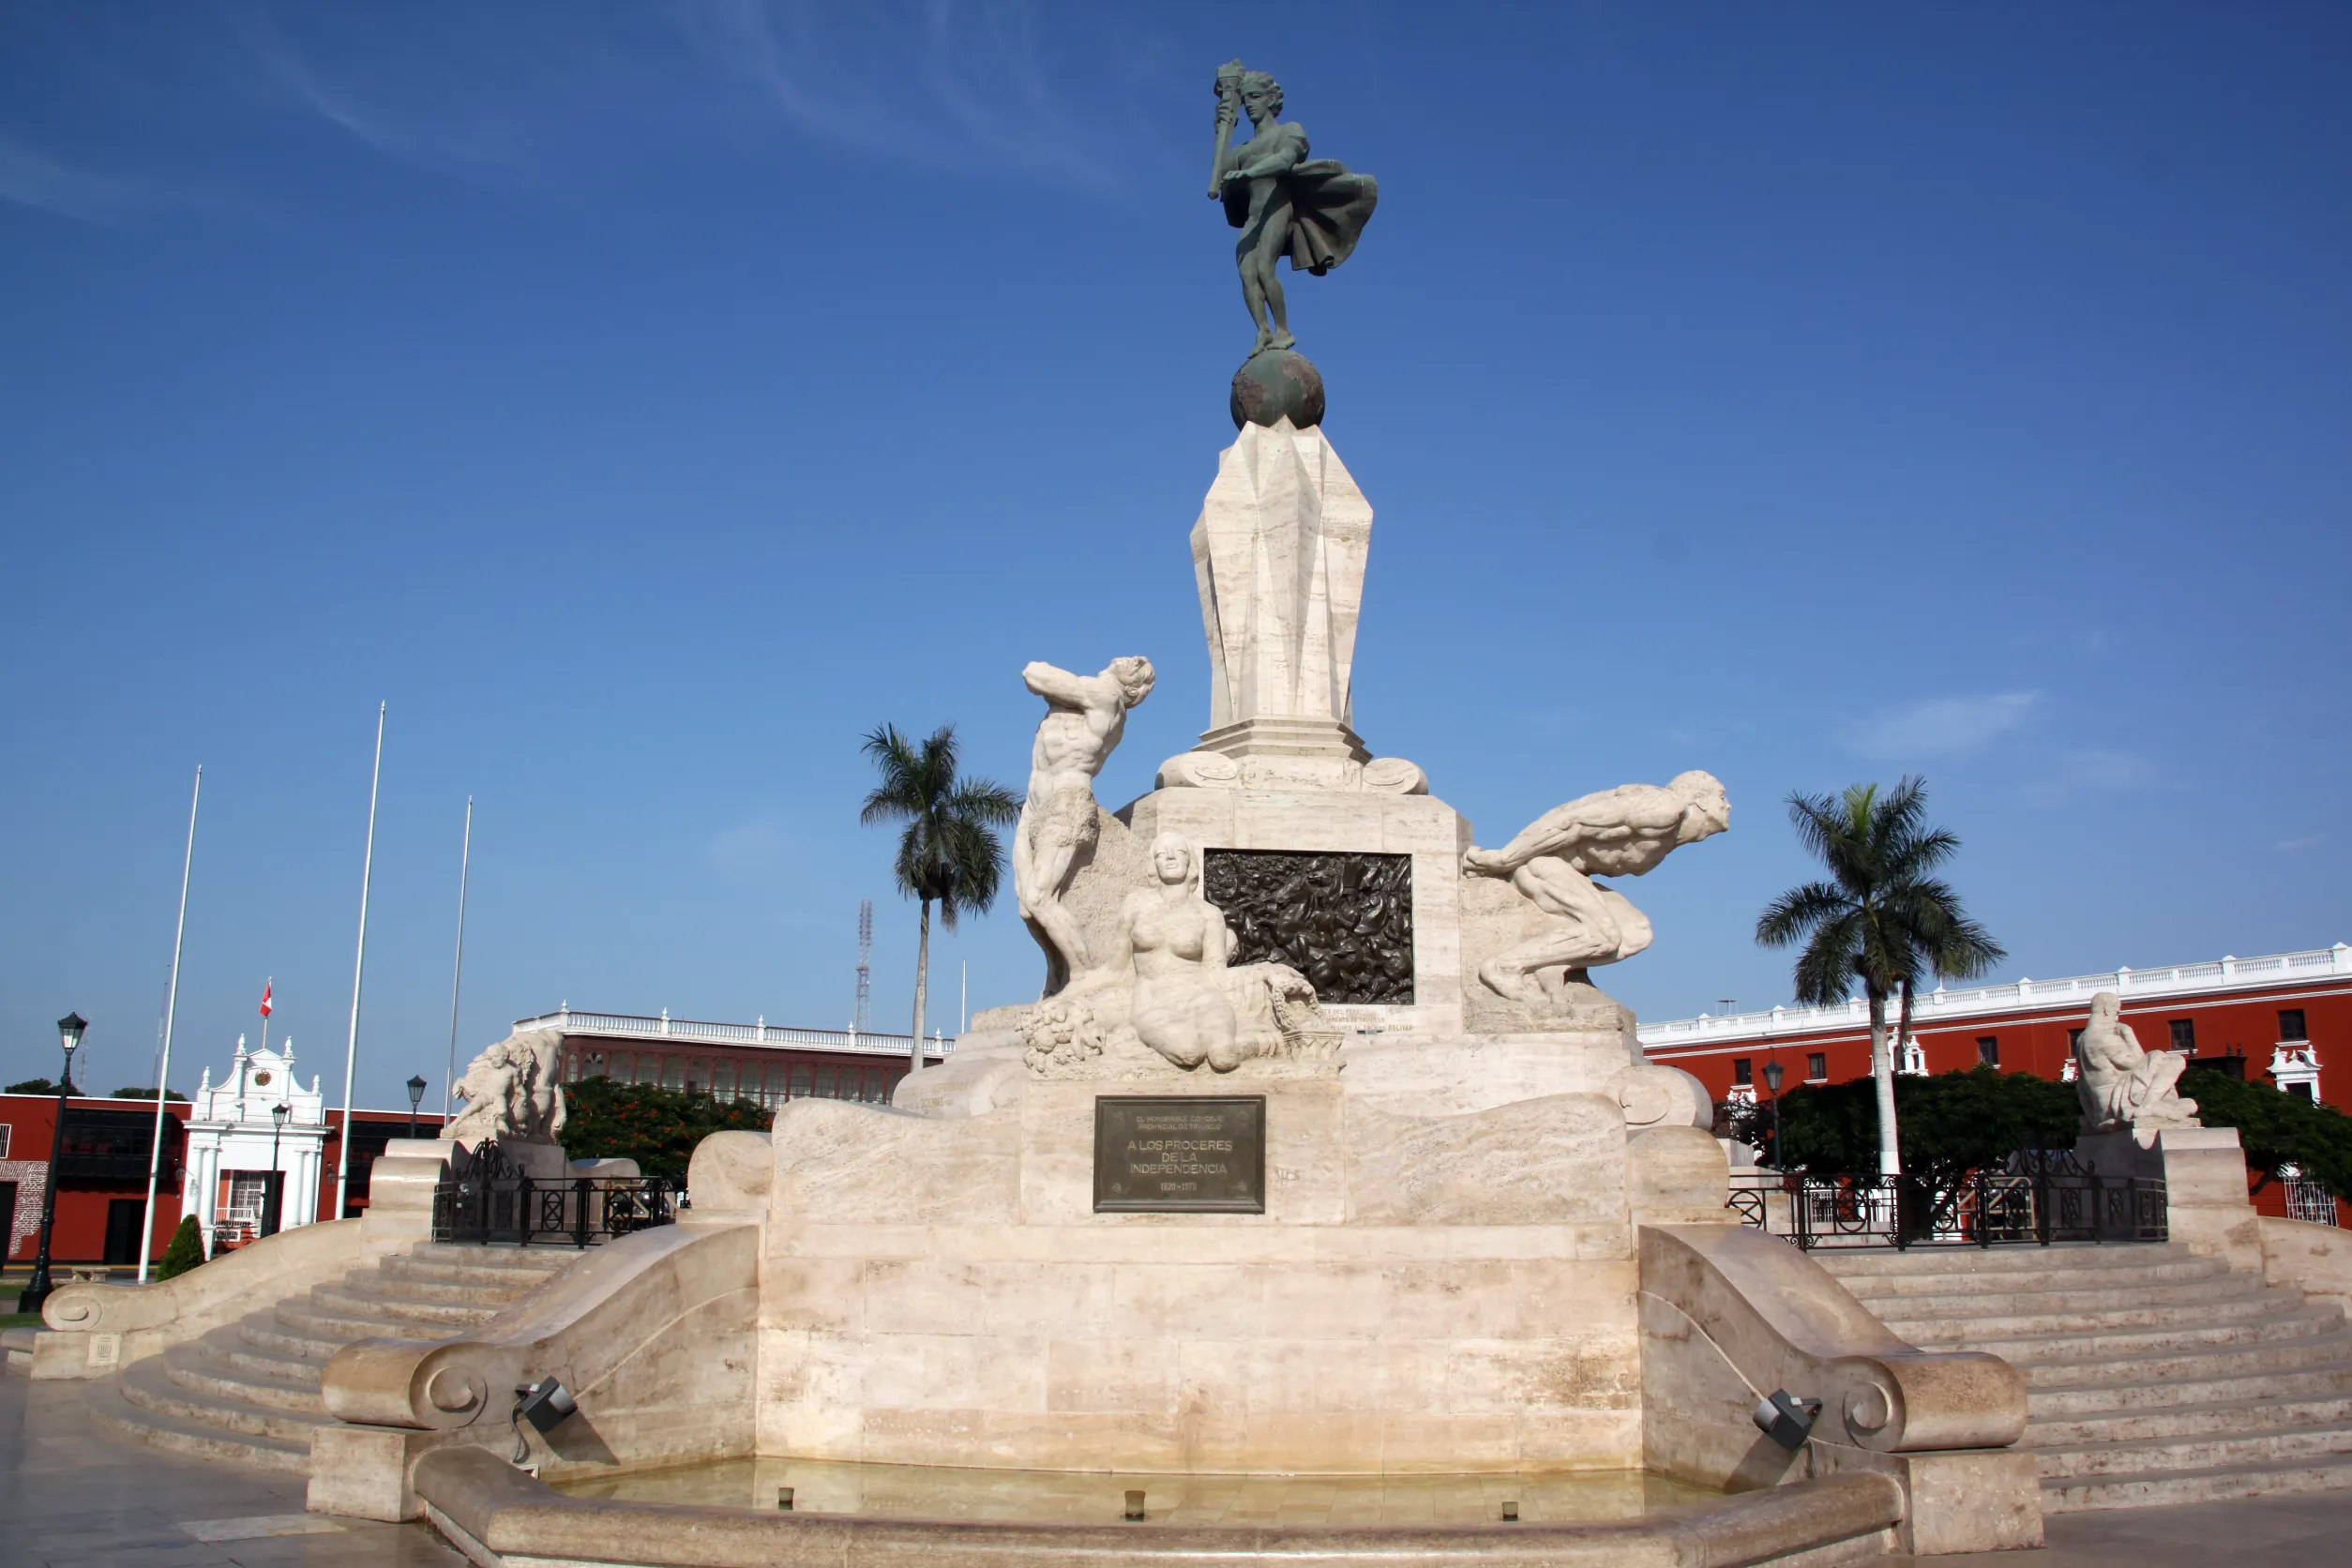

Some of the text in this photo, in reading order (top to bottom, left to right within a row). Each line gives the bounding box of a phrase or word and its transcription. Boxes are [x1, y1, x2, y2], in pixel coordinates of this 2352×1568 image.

[1127, 1140, 1233, 1151] A LOS PROCERES
[1162, 1152, 1198, 1162] DE LA
[1130, 1164, 1228, 1174] INDEPENDENCIA
